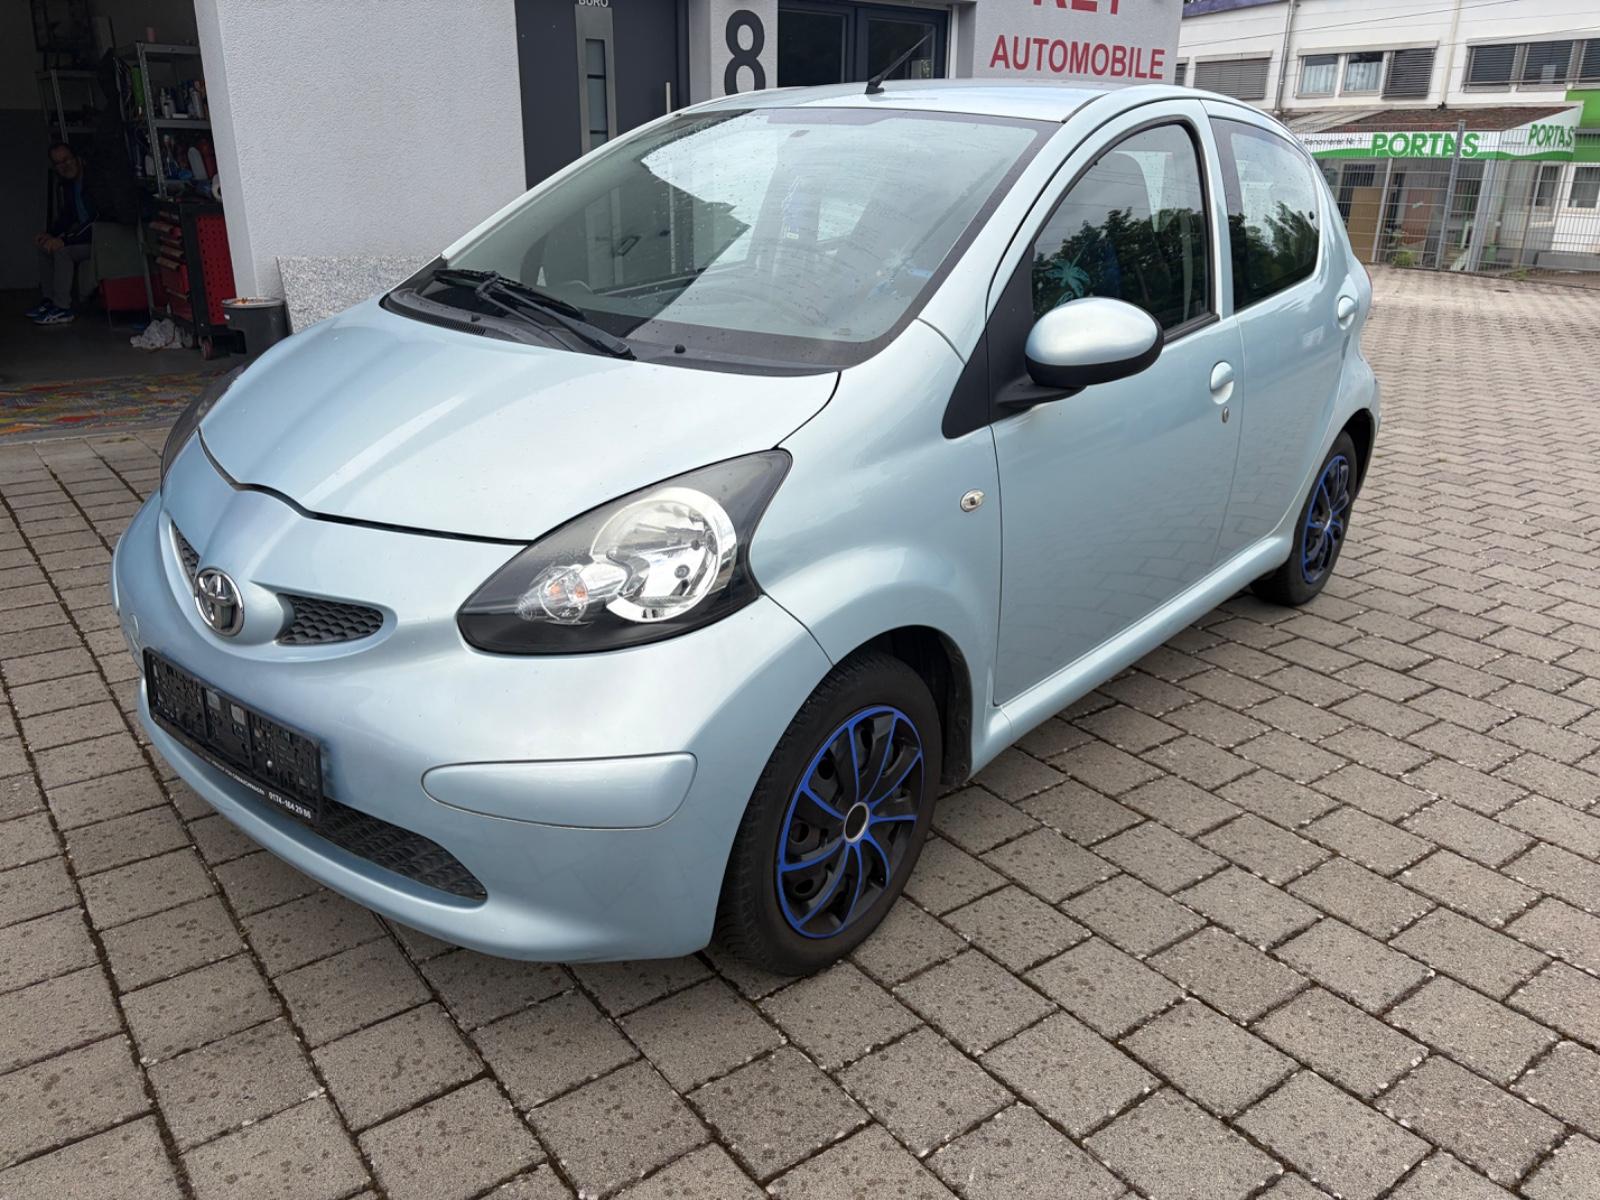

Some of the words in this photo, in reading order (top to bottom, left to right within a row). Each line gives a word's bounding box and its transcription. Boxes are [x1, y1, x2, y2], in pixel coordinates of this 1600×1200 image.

[724, 9, 766, 96] 8
[989, 34, 1166, 80] AUTOMOBILE
[1371, 132, 1480, 158] PORTAS
[1526, 123, 1575, 147] PORTAS
